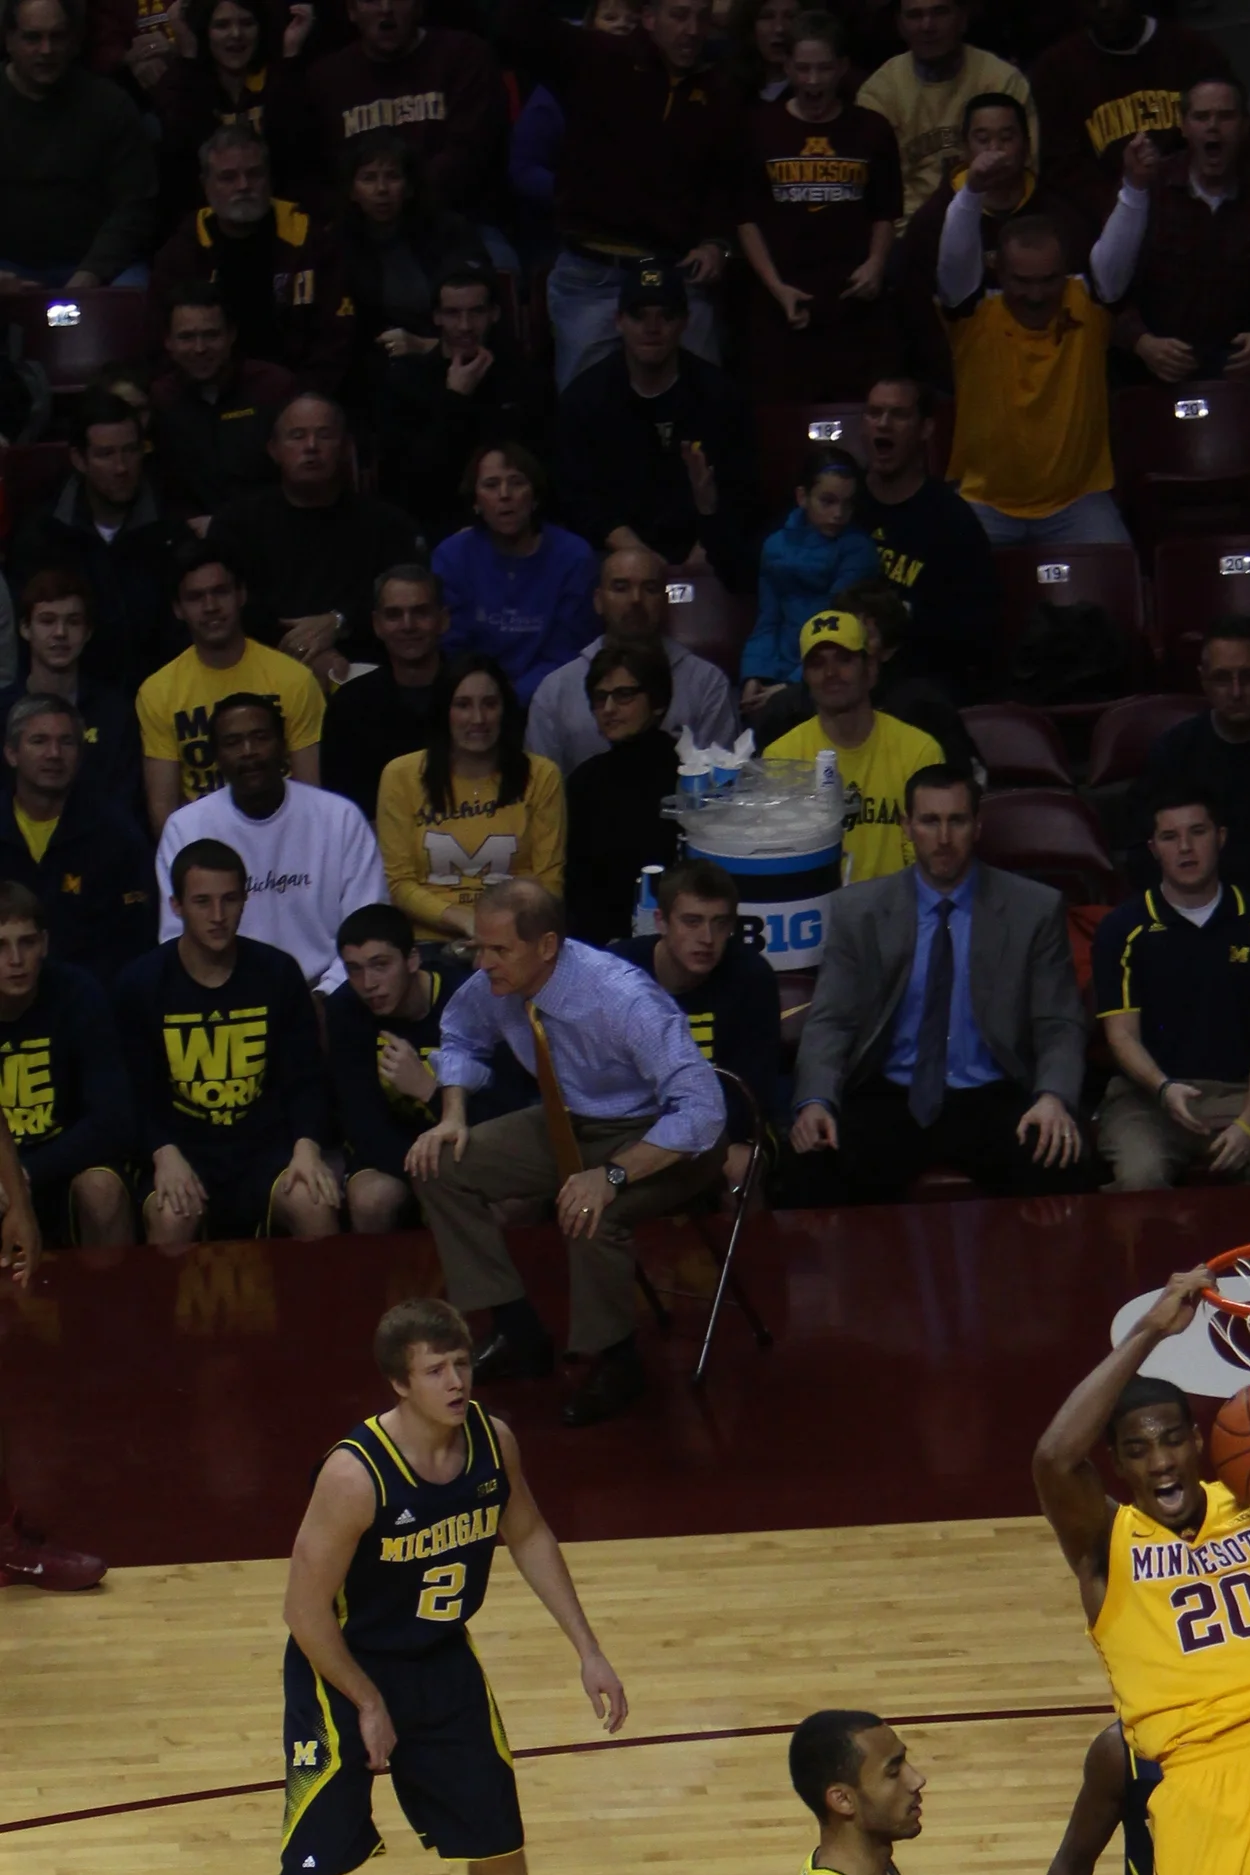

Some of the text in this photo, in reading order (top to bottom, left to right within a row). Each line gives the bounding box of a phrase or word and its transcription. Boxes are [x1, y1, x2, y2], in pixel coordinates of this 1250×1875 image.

[1084, 89, 1182, 158] MINNESOT
[811, 616, 840, 635] M
[245, 869, 312, 894] ichigan
[423, 829, 518, 886] M
[163, 1020, 269, 1082] WE
[379, 1504, 500, 1563] MICHIGAN
[416, 1561, 467, 1622] 2
[293, 1740, 318, 1767] M
